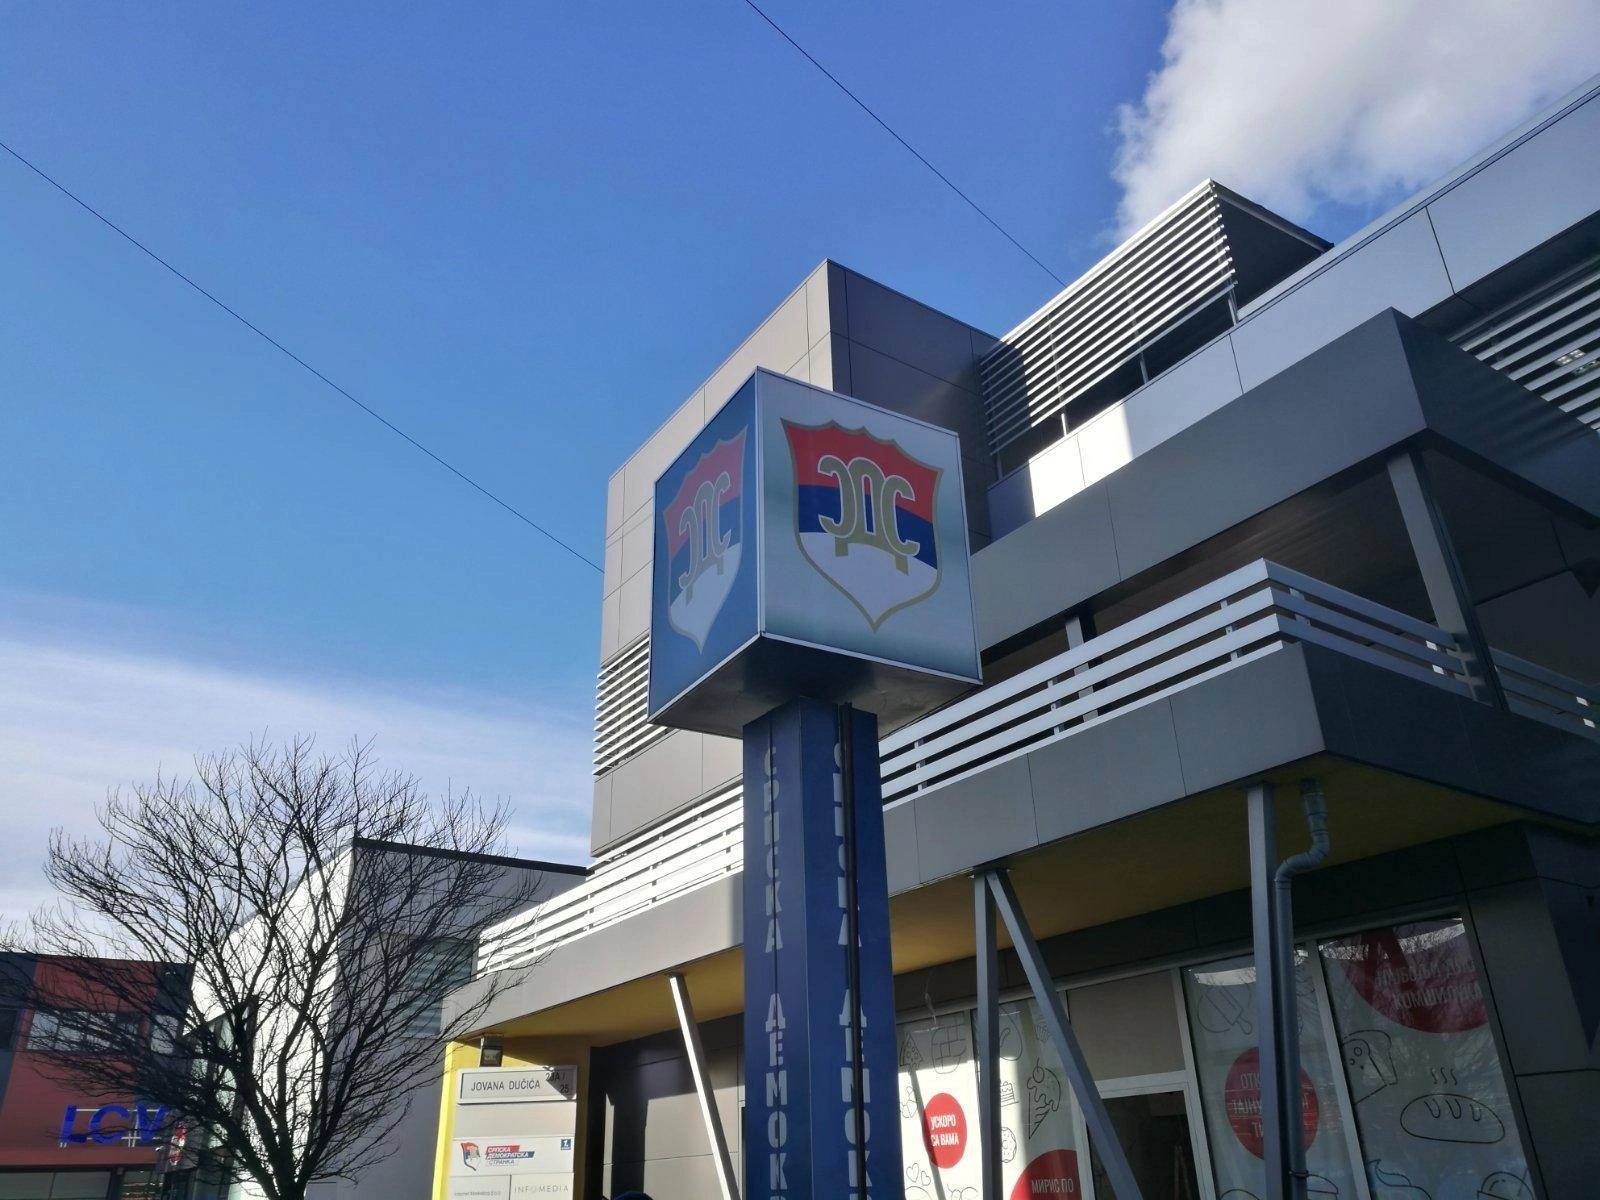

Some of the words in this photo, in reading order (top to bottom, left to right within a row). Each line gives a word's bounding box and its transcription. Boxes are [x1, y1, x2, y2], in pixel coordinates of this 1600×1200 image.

[471, 1080, 505, 1092] JOVANA
[509, 1078, 541, 1090] DUČIĆA
[765, 992, 788, 1200] ДЕМОК
[930, 1114, 957, 1130] УСКОРО
[940, 1132, 960, 1146] ВАМА
[1031, 1178, 1060, 1194] МИРИС
